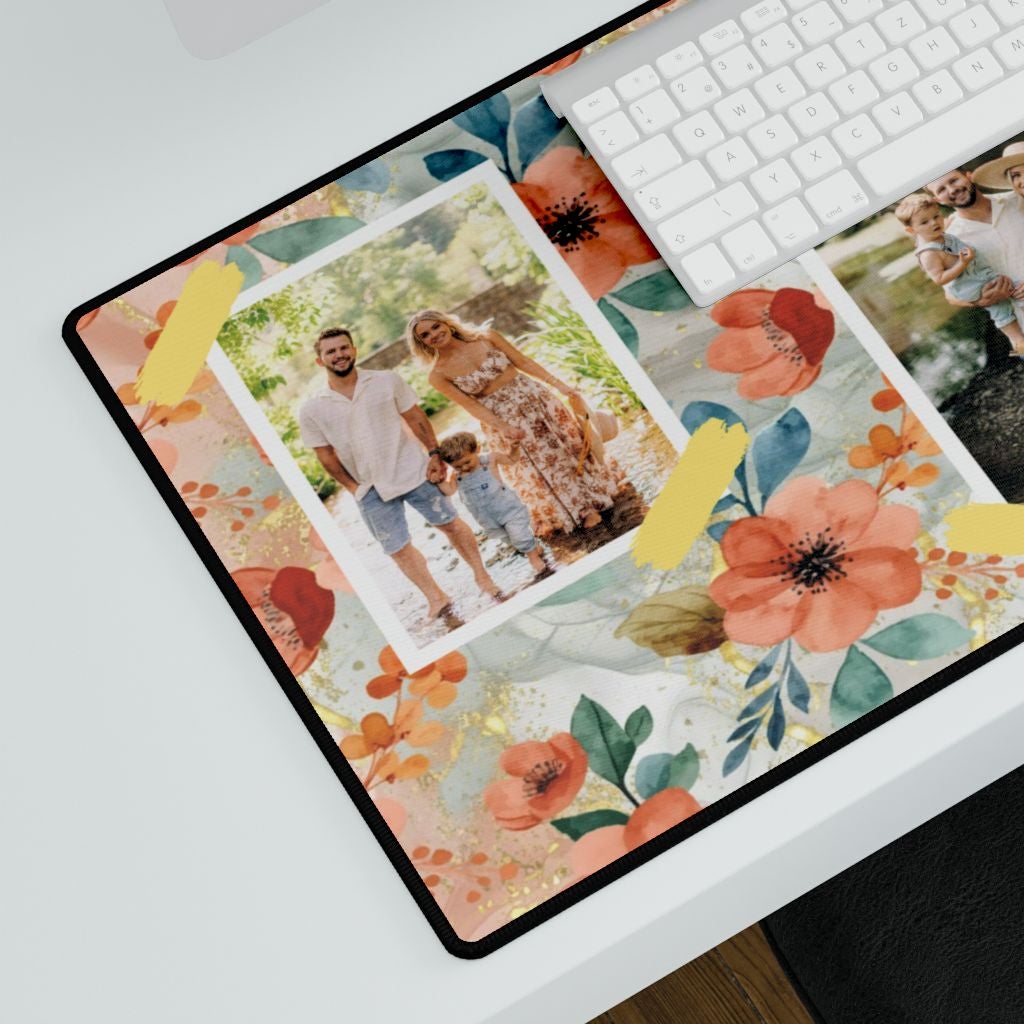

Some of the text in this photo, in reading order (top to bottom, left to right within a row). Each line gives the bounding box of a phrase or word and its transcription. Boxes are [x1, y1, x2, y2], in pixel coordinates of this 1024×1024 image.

[799, 16, 808, 26] 5
[897, 17, 907, 28] Z
[760, 38, 768, 48] 4
[855, 39, 865, 49] T
[927, 40, 938, 50] H
[1012, 40, 1024, 51] M
[717, 61, 727, 72] 3
[816, 61, 826, 71] R
[888, 62, 898, 72] G
[972, 62, 984, 72] N
[677, 83, 687, 93] 2
[776, 83, 786, 93] E
[847, 84, 856, 94] F
[932, 84, 942, 94] B
[635, 105, 644, 115] 1
[733, 105, 746, 116] W
[806, 107, 816, 118] D
[890, 105, 900, 115] V
[694, 127, 705, 137] Q
[765, 129, 775, 139] S
[852, 128, 862, 138] C
[726, 152, 736, 163] A
[810, 150, 821, 161] X
[768, 173, 778, 183] Y
[826, 206, 843, 219] cmd
